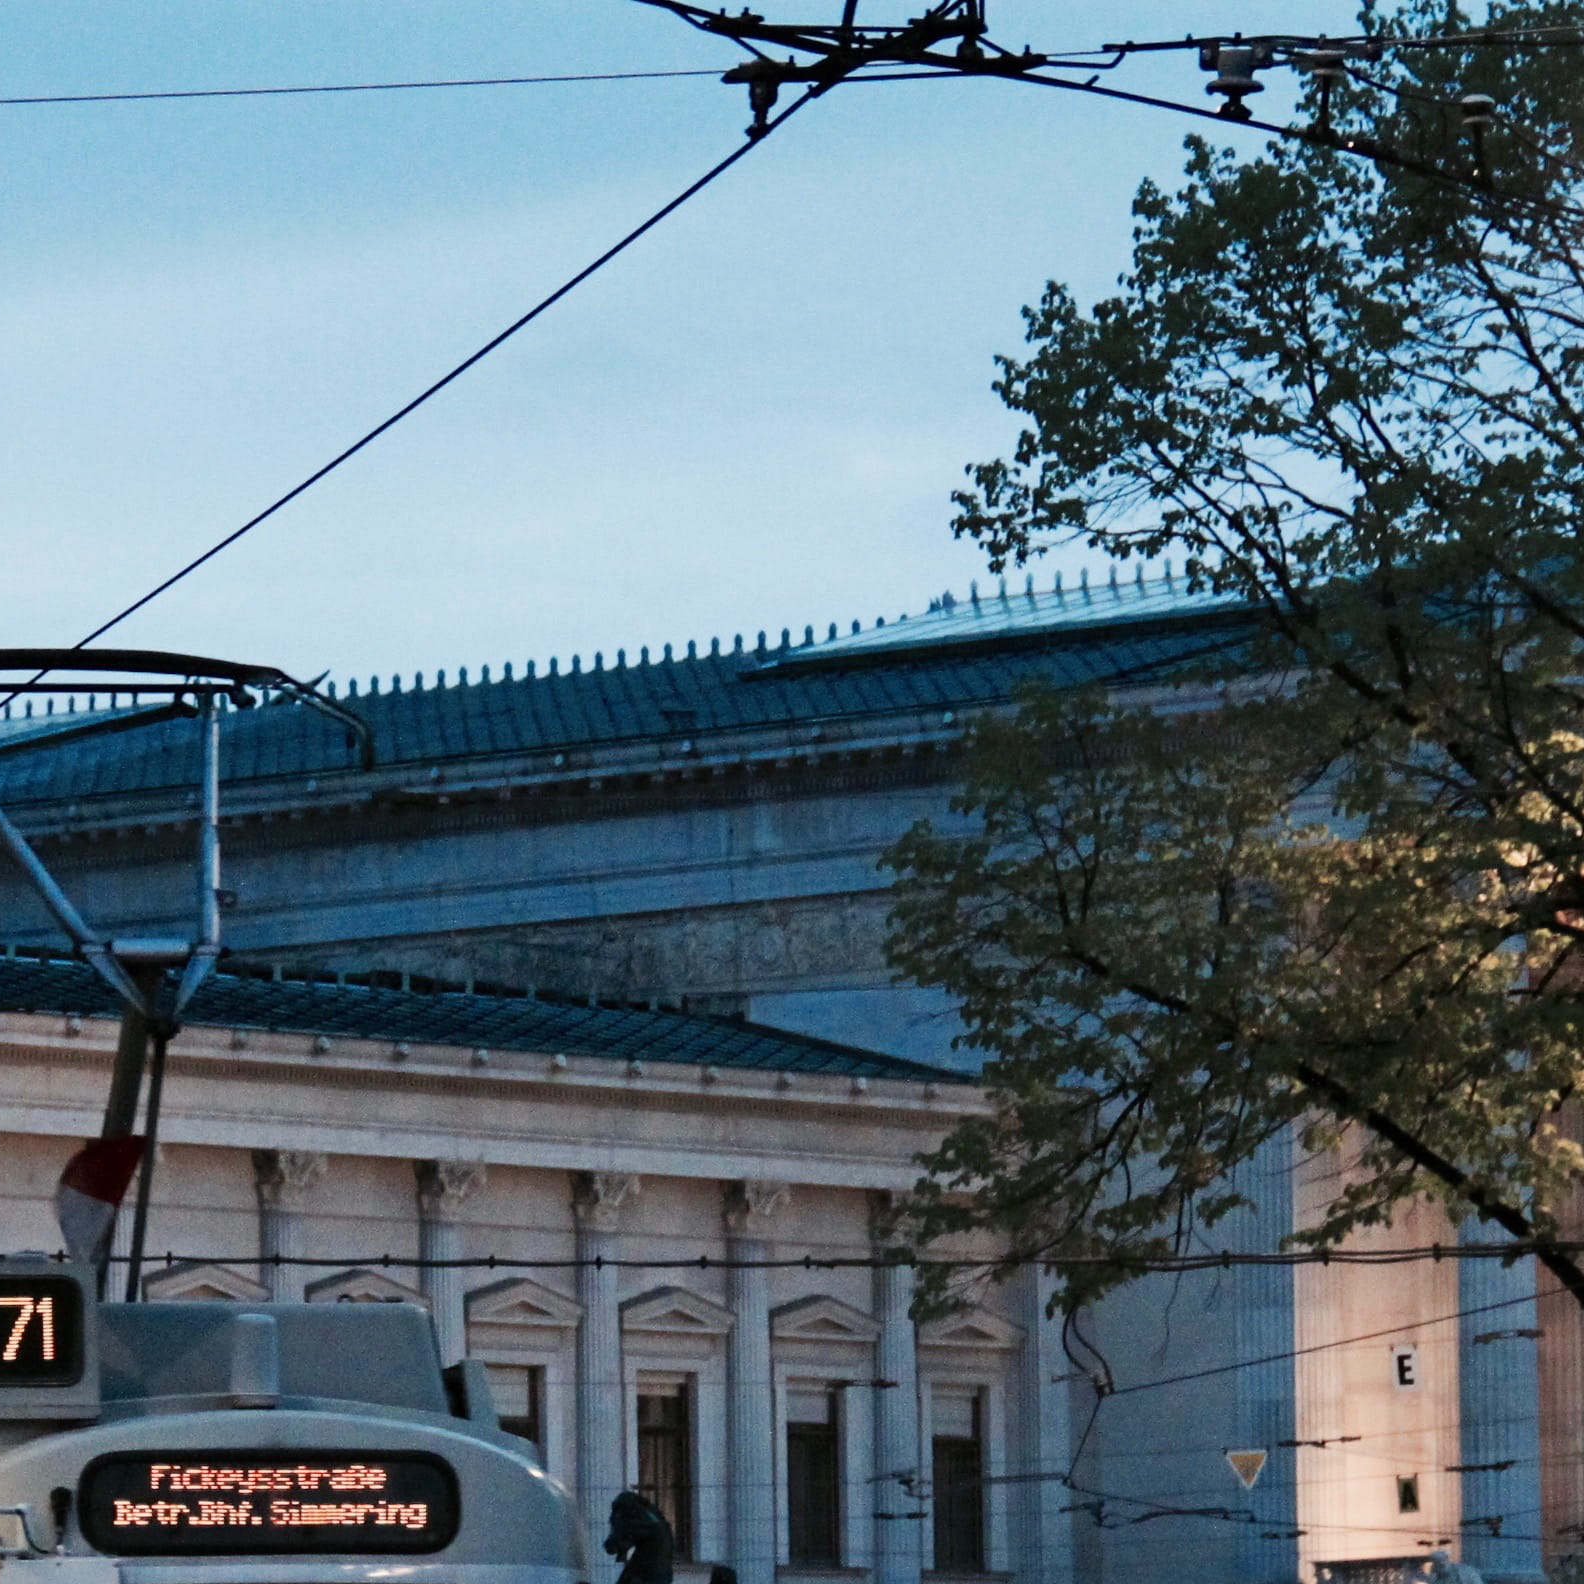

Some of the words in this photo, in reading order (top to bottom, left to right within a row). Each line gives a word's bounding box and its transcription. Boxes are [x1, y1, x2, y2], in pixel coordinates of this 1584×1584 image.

[1397, 1354, 1415, 1386] E
[151, 1464, 386, 1494] Fickeysstraße
[270, 1500, 428, 1529] Simmering
